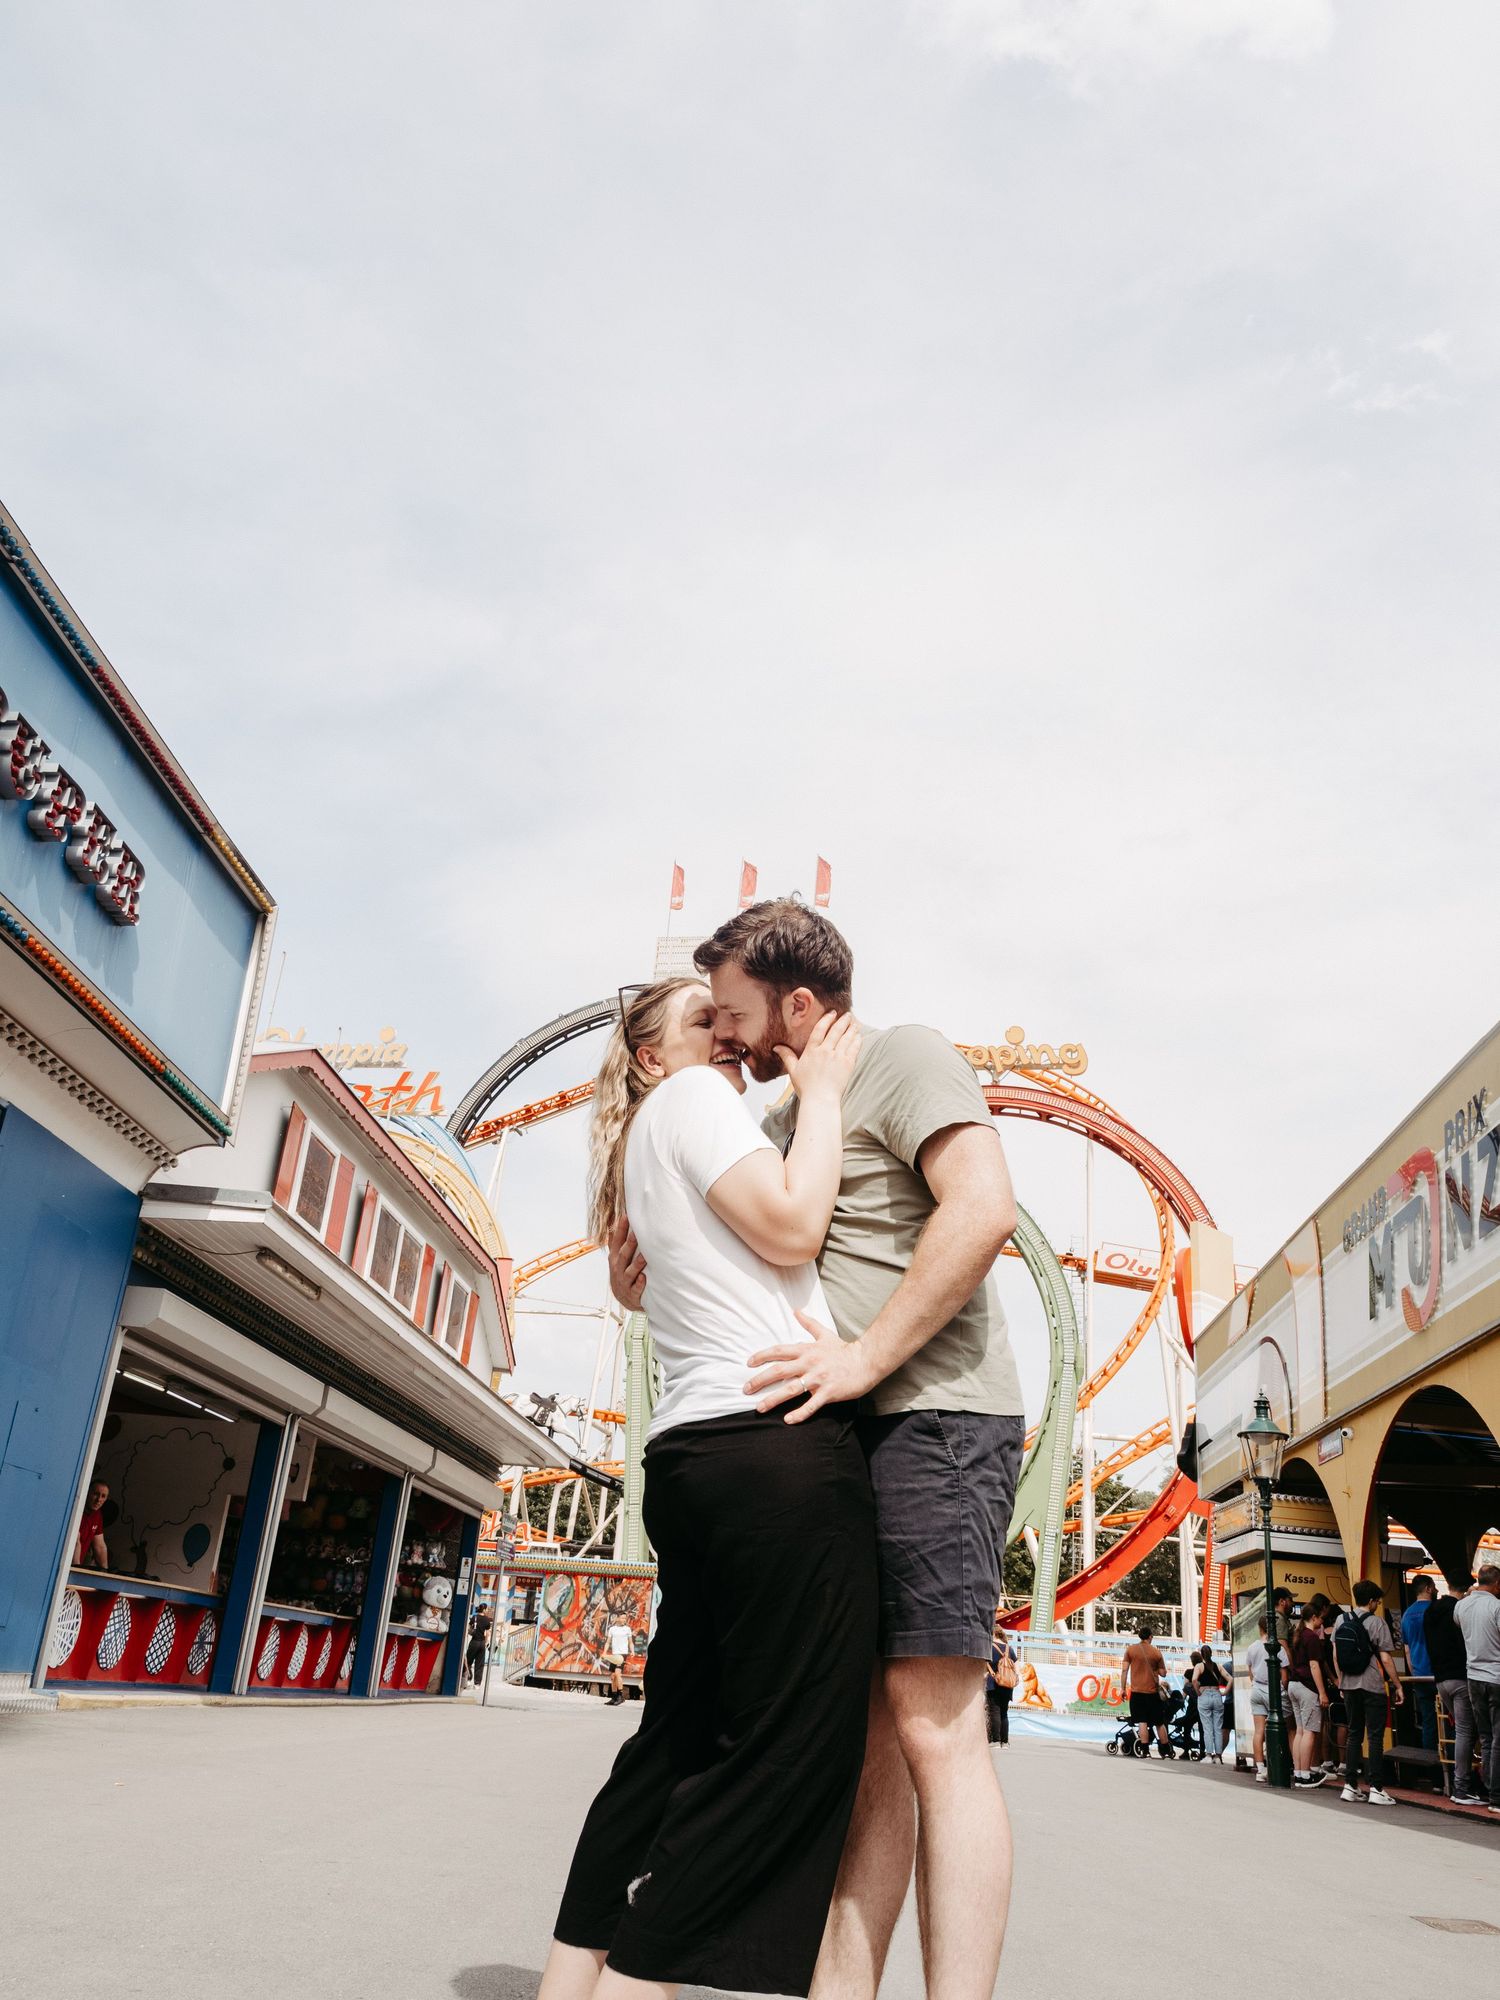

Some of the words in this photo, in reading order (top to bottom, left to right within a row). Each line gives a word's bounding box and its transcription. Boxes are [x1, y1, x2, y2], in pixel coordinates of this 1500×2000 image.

[967, 1025, 1088, 1076] oping
[1343, 1186, 1388, 1254] GRAND
[1444, 1086, 1488, 1162] PRIX
[1284, 1573, 1315, 1585] Kassa
[1077, 1673, 1131, 1707] Oly
